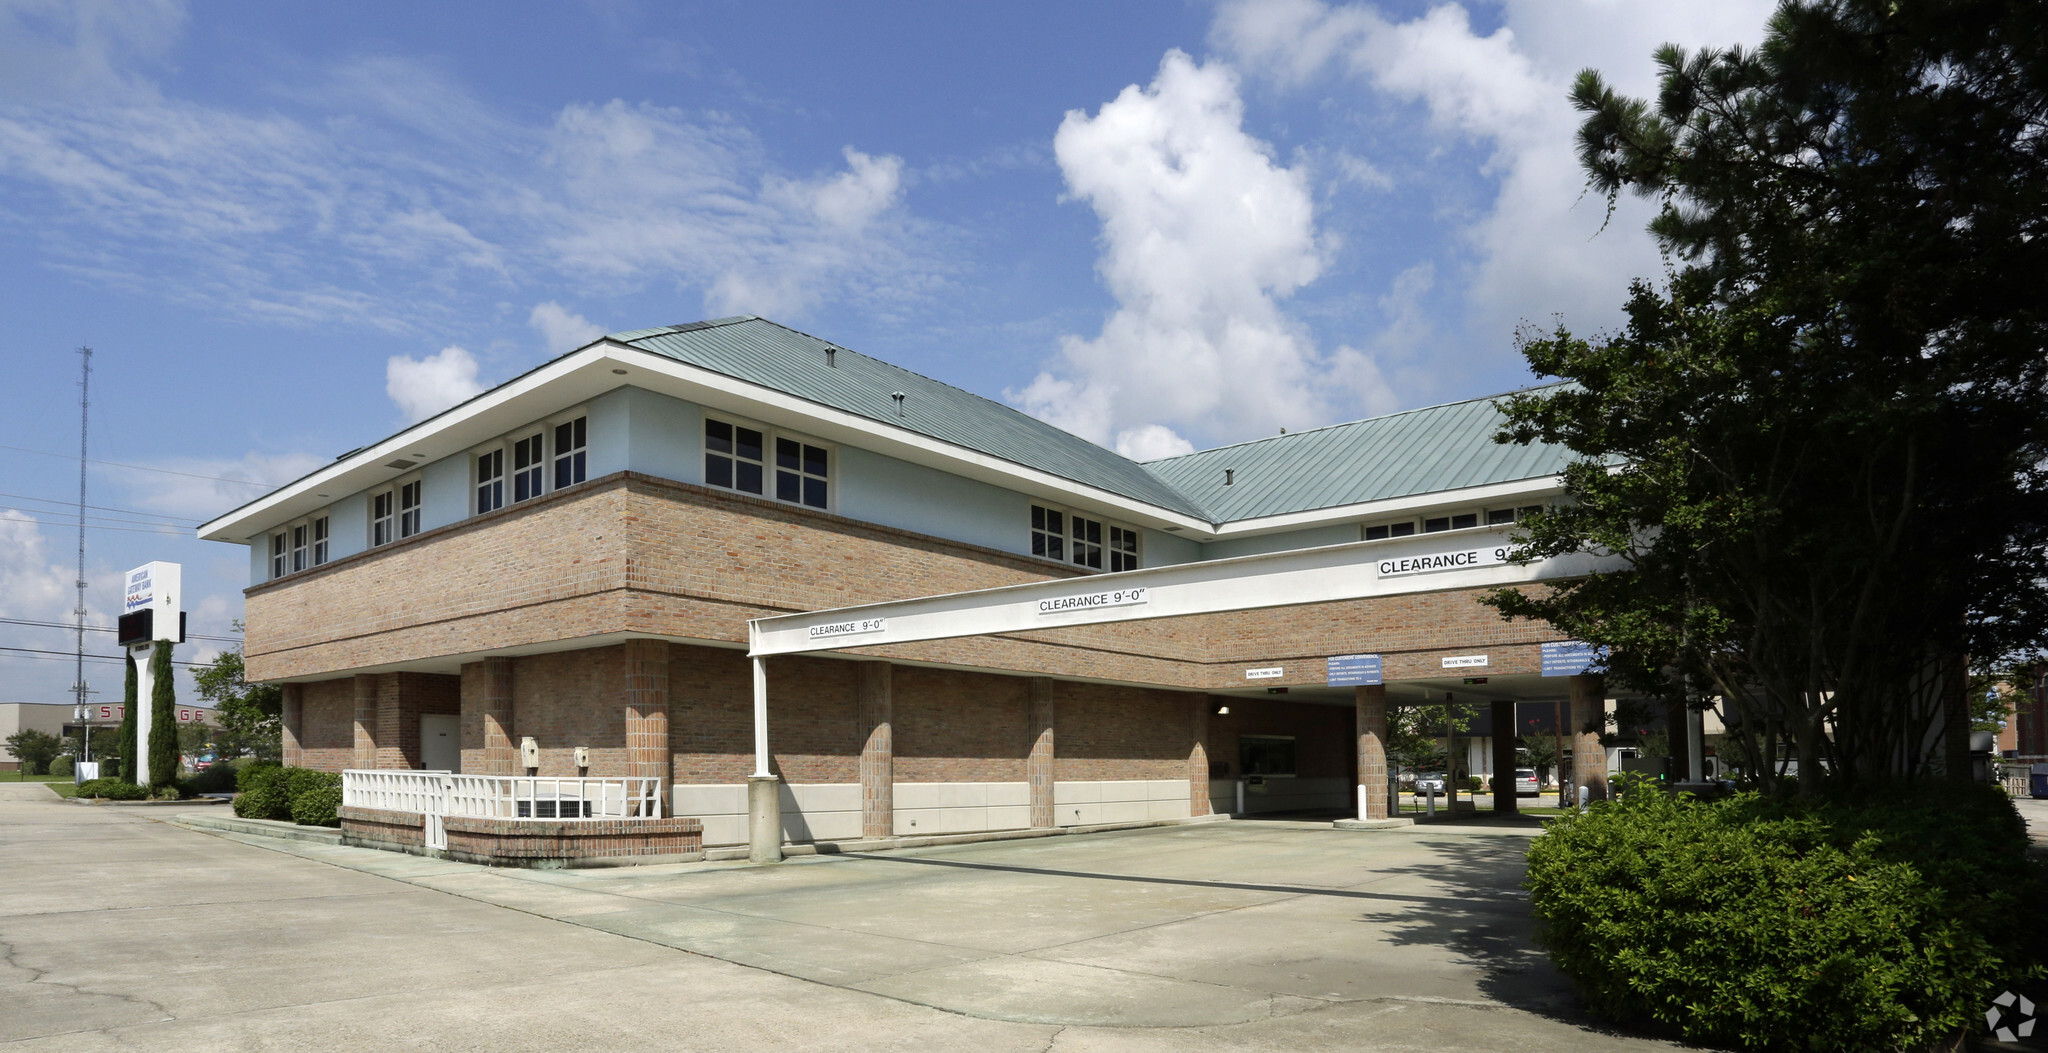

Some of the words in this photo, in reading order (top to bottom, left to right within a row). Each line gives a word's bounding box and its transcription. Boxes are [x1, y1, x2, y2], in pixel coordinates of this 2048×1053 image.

[1380, 552, 1477, 574] CLEARANCE
[131, 569, 148, 583] AMERICAN
[141, 579, 152, 590] BANK
[1040, 594, 1108, 611] CLEARANCE
[1113, 588, 1145, 602] 9'-0"
[810, 623, 855, 636] CLEARANCE
